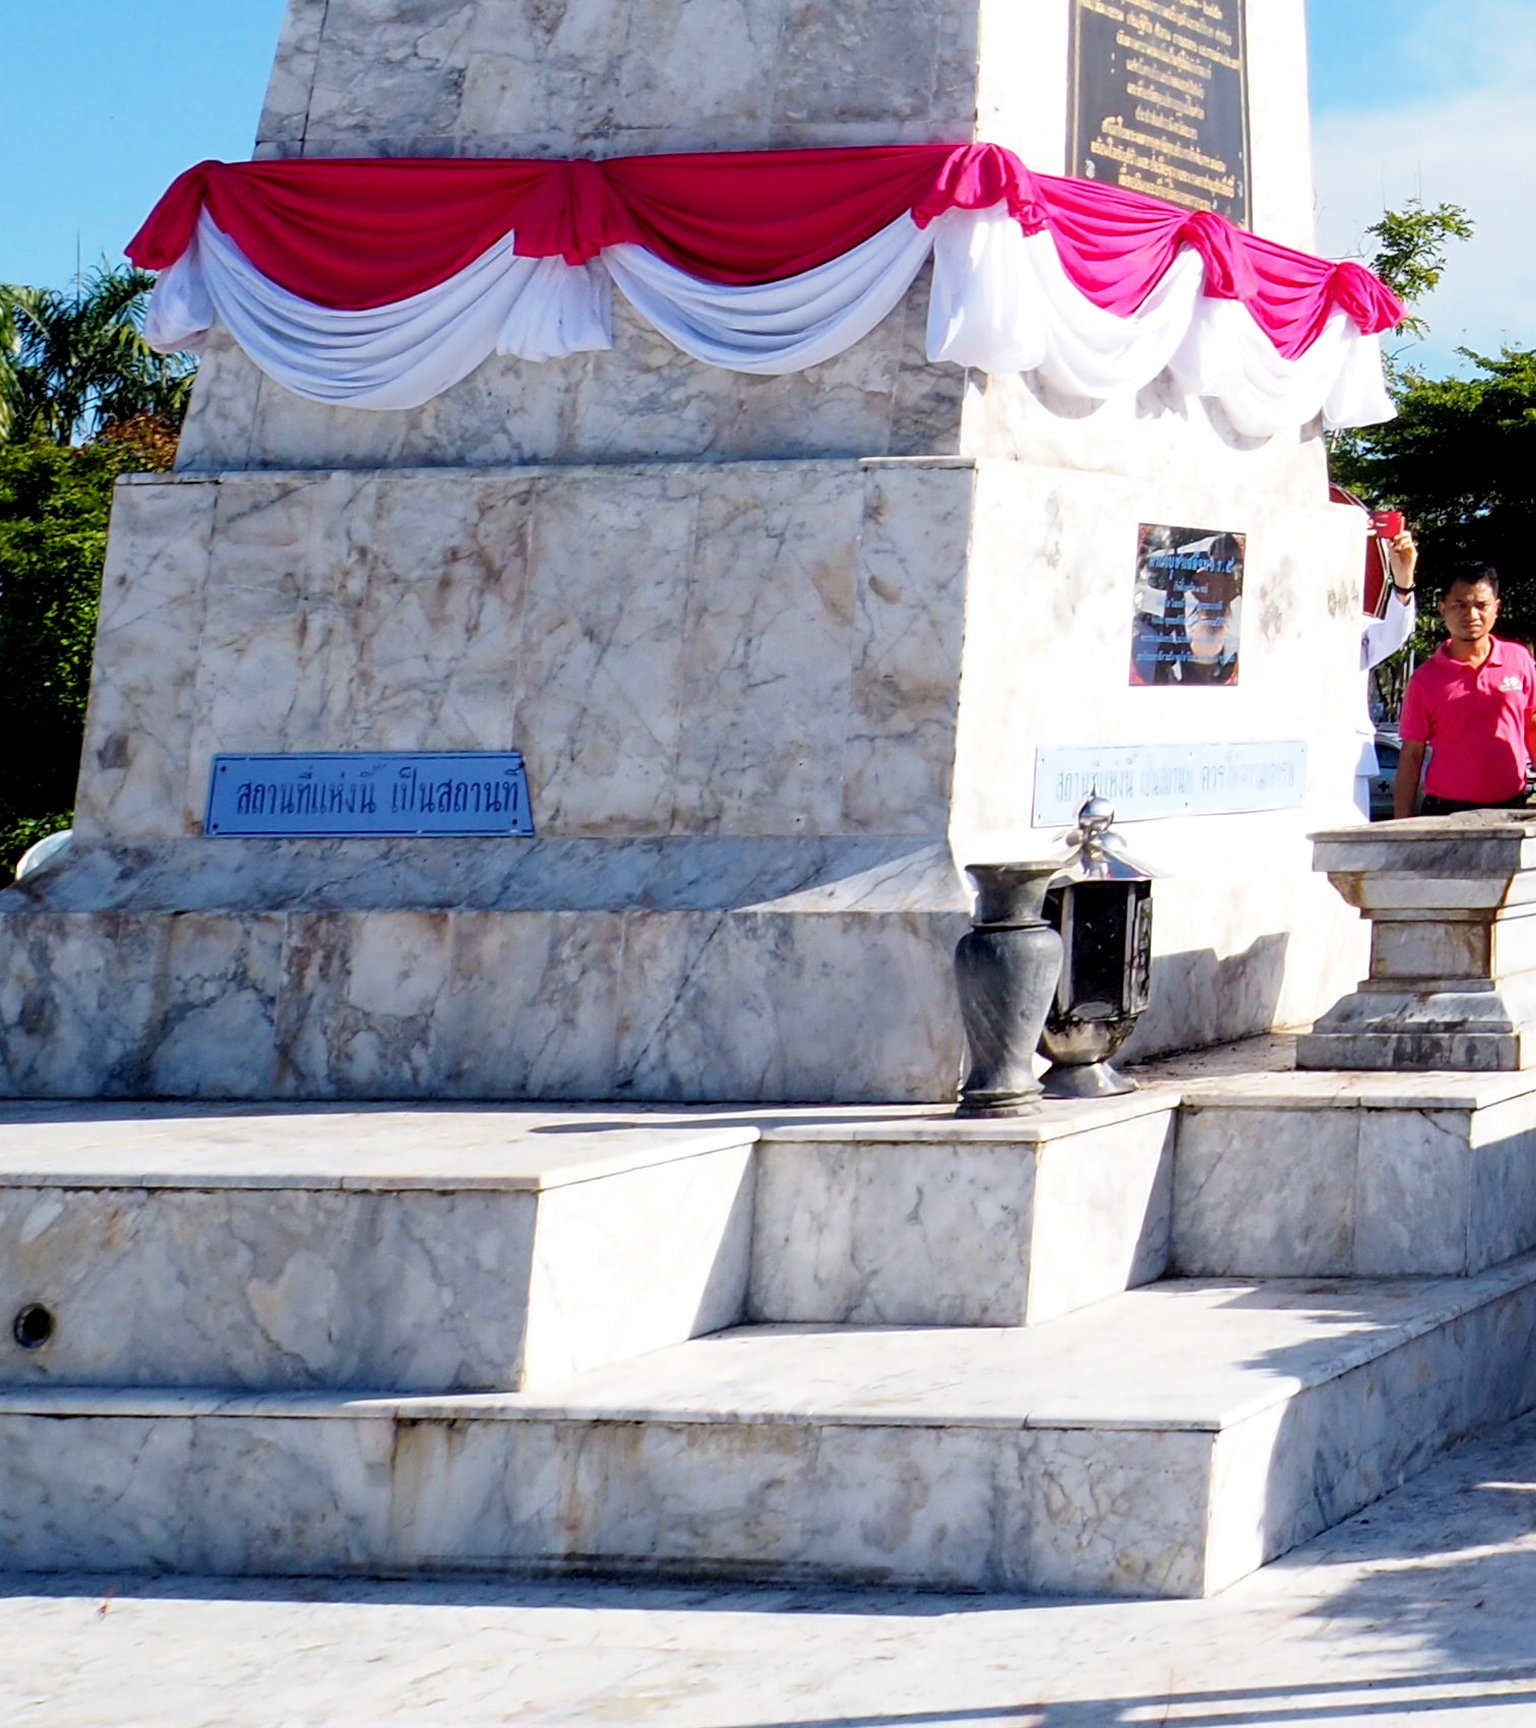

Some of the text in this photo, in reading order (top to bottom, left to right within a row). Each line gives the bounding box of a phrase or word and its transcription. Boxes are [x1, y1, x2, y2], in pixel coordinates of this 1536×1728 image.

[236, 763, 387, 814] สถานที่แห่งนี้
